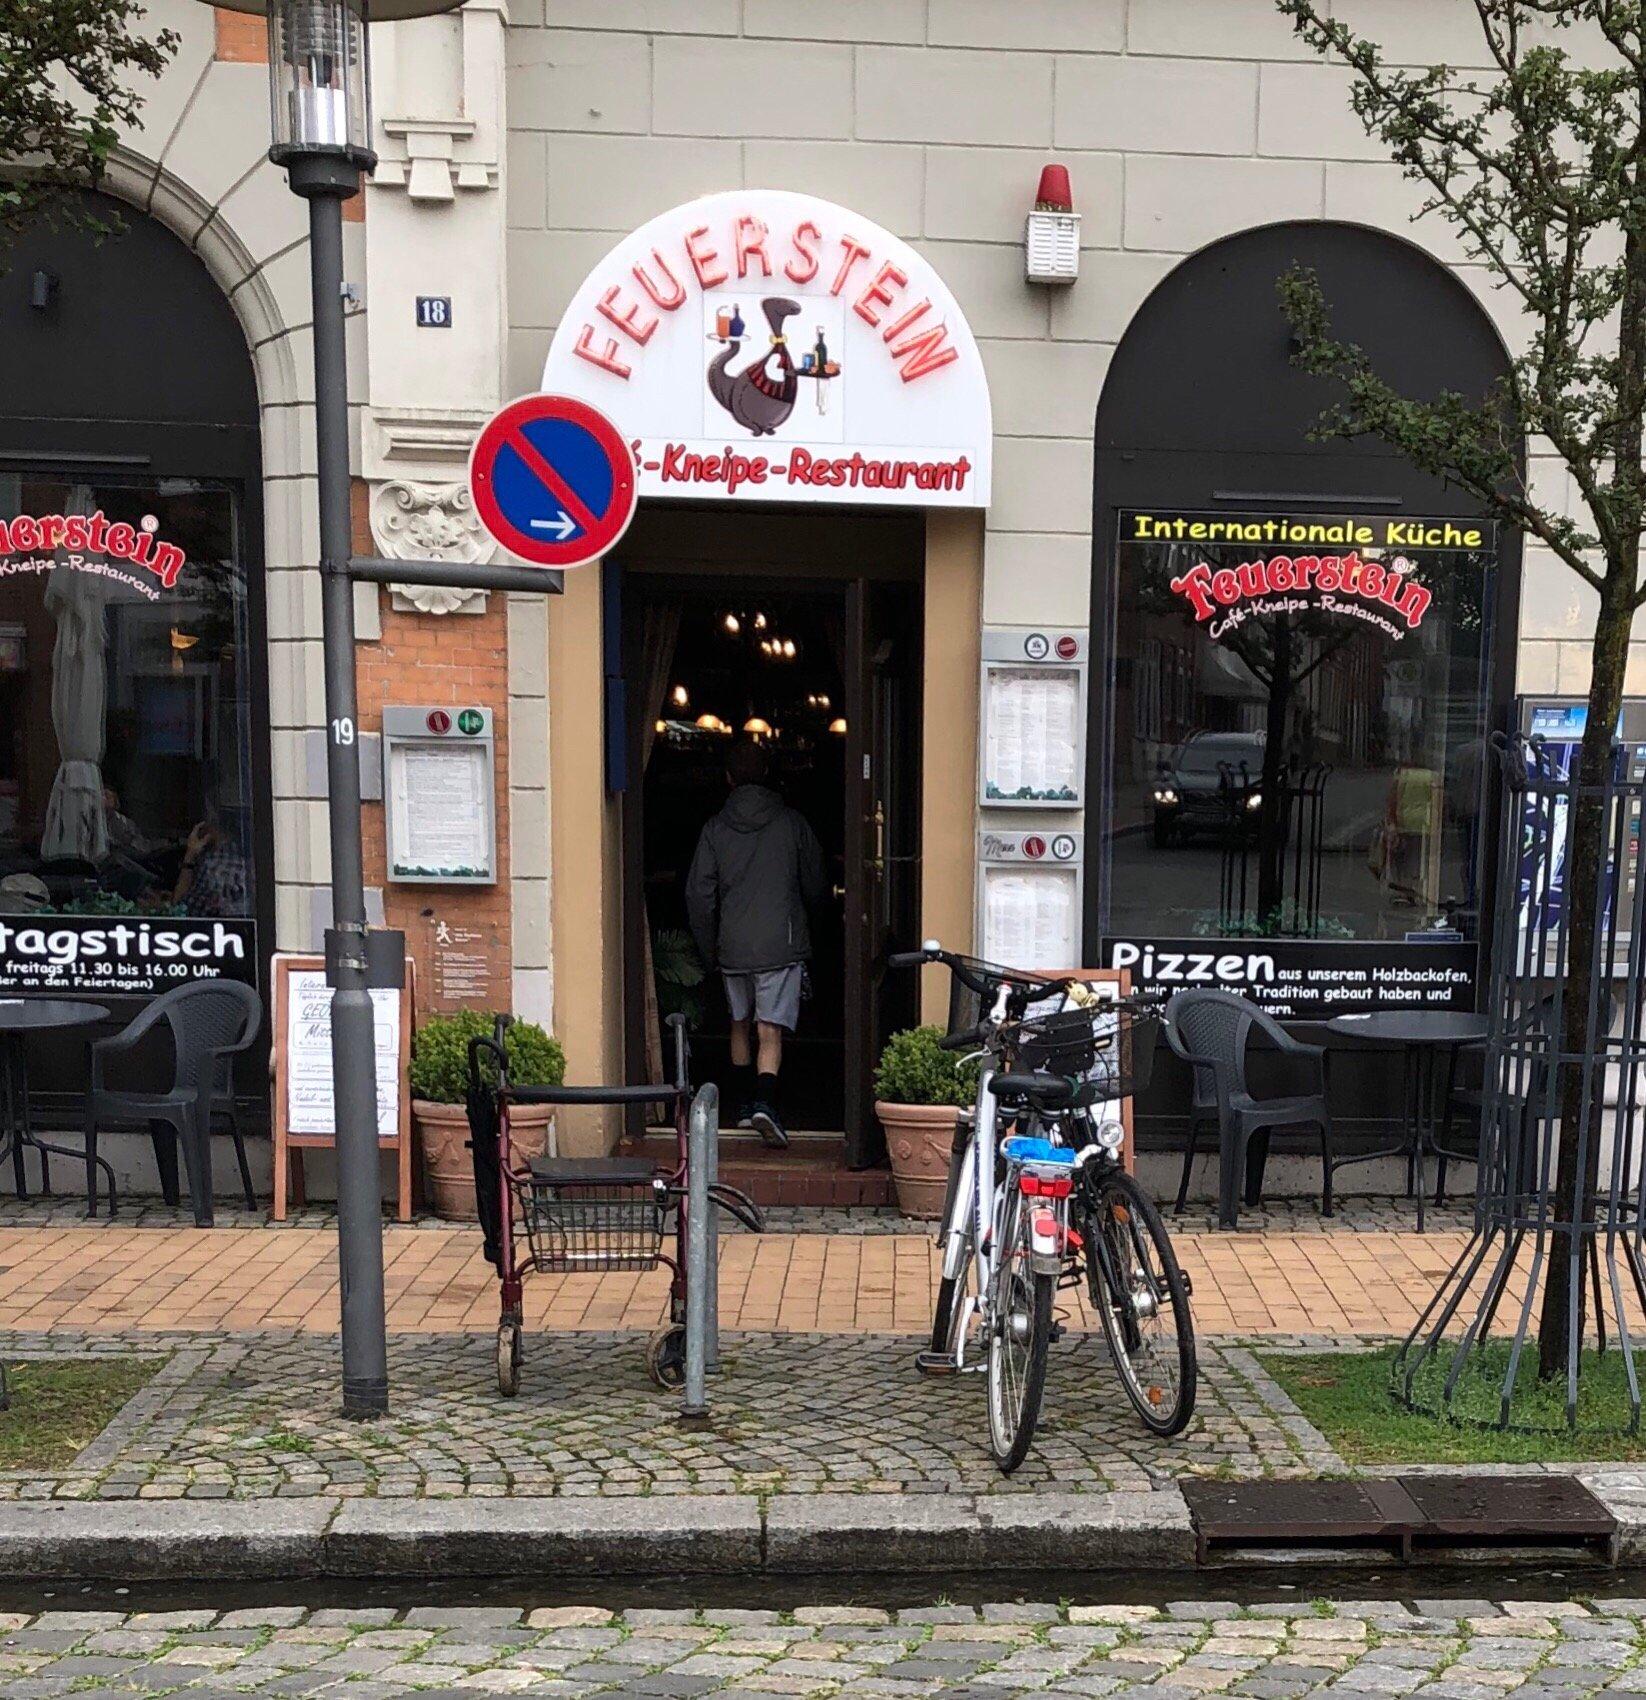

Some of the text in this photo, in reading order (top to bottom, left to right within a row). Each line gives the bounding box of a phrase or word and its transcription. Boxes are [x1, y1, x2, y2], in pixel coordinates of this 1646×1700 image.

[422, 300, 446, 324] 18
[572, 214, 959, 386] FEUERSTEIN
[1134, 515, 1482, 547] Internationale Küche
[1170, 551, 1432, 628] Feuerstein
[332, 717, 354, 745] 19
[6, 960, 221, 977] freitags 11.30 bis 16.00 Uhr
[1112, 942, 1472, 984] Pizzen aus unserem Holzbackofen,
[22, 977, 40, 986] an
[44, 976, 70, 987] den
[74, 976, 154, 990] Feiertagen)
[1253, 984, 1319, 999] Tradition
[1324, 987, 1374, 1002] gebaut
[1379, 987, 1422, 1001] haben
[1426, 988, 1452, 1000] und
